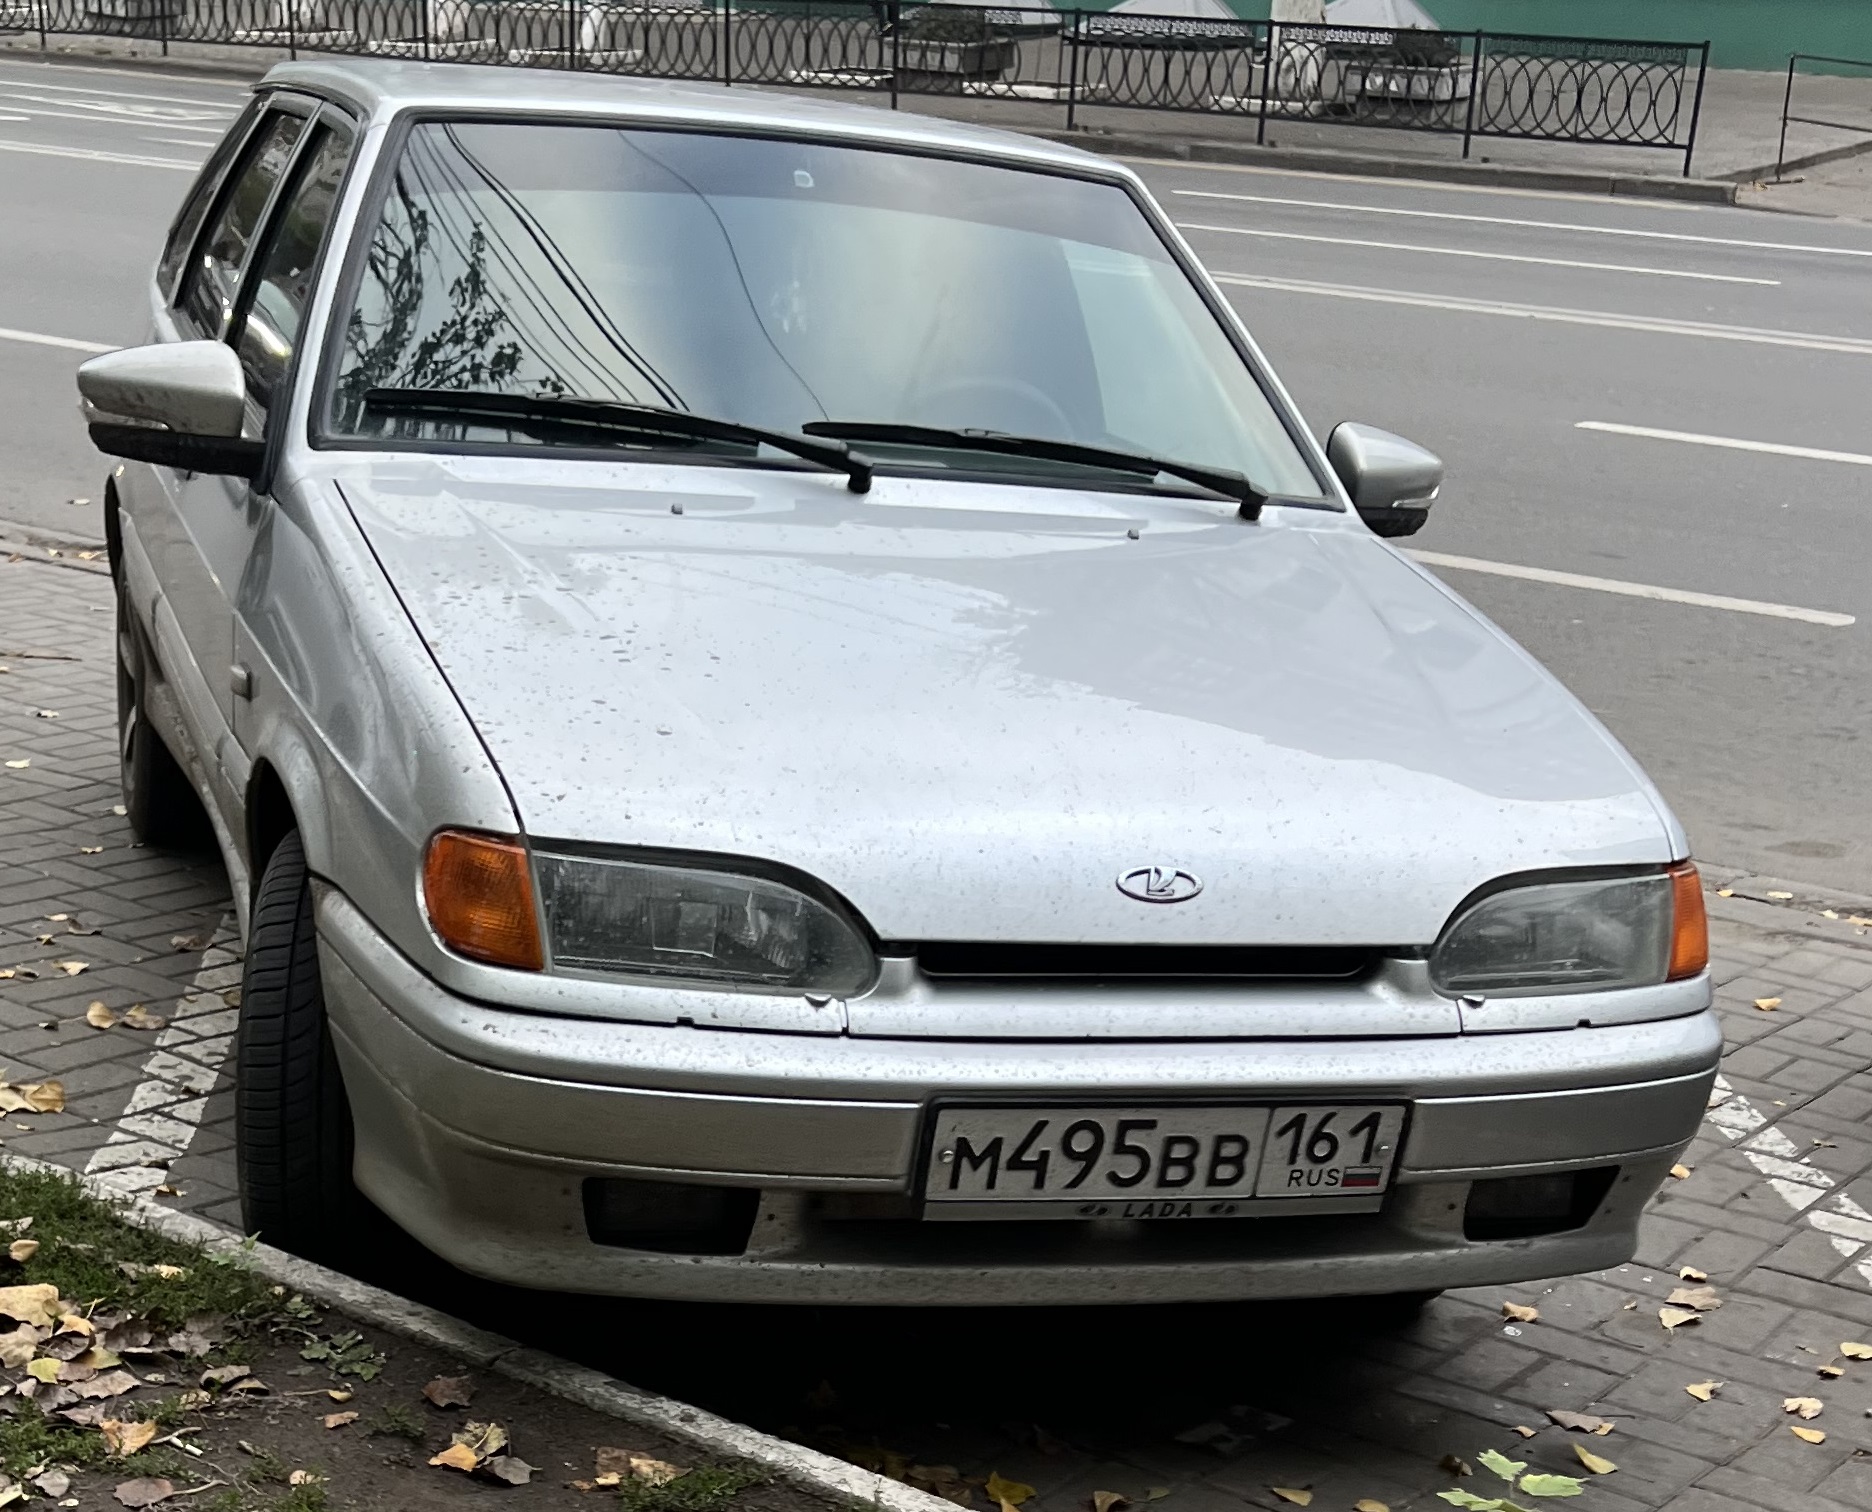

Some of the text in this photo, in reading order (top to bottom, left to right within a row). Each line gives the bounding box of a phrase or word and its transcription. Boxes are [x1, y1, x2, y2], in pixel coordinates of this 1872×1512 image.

[1276, 1111, 1383, 1165] 161
[1286, 1168, 1340, 1188] RUS
[1122, 1201, 1194, 1219] LADA
